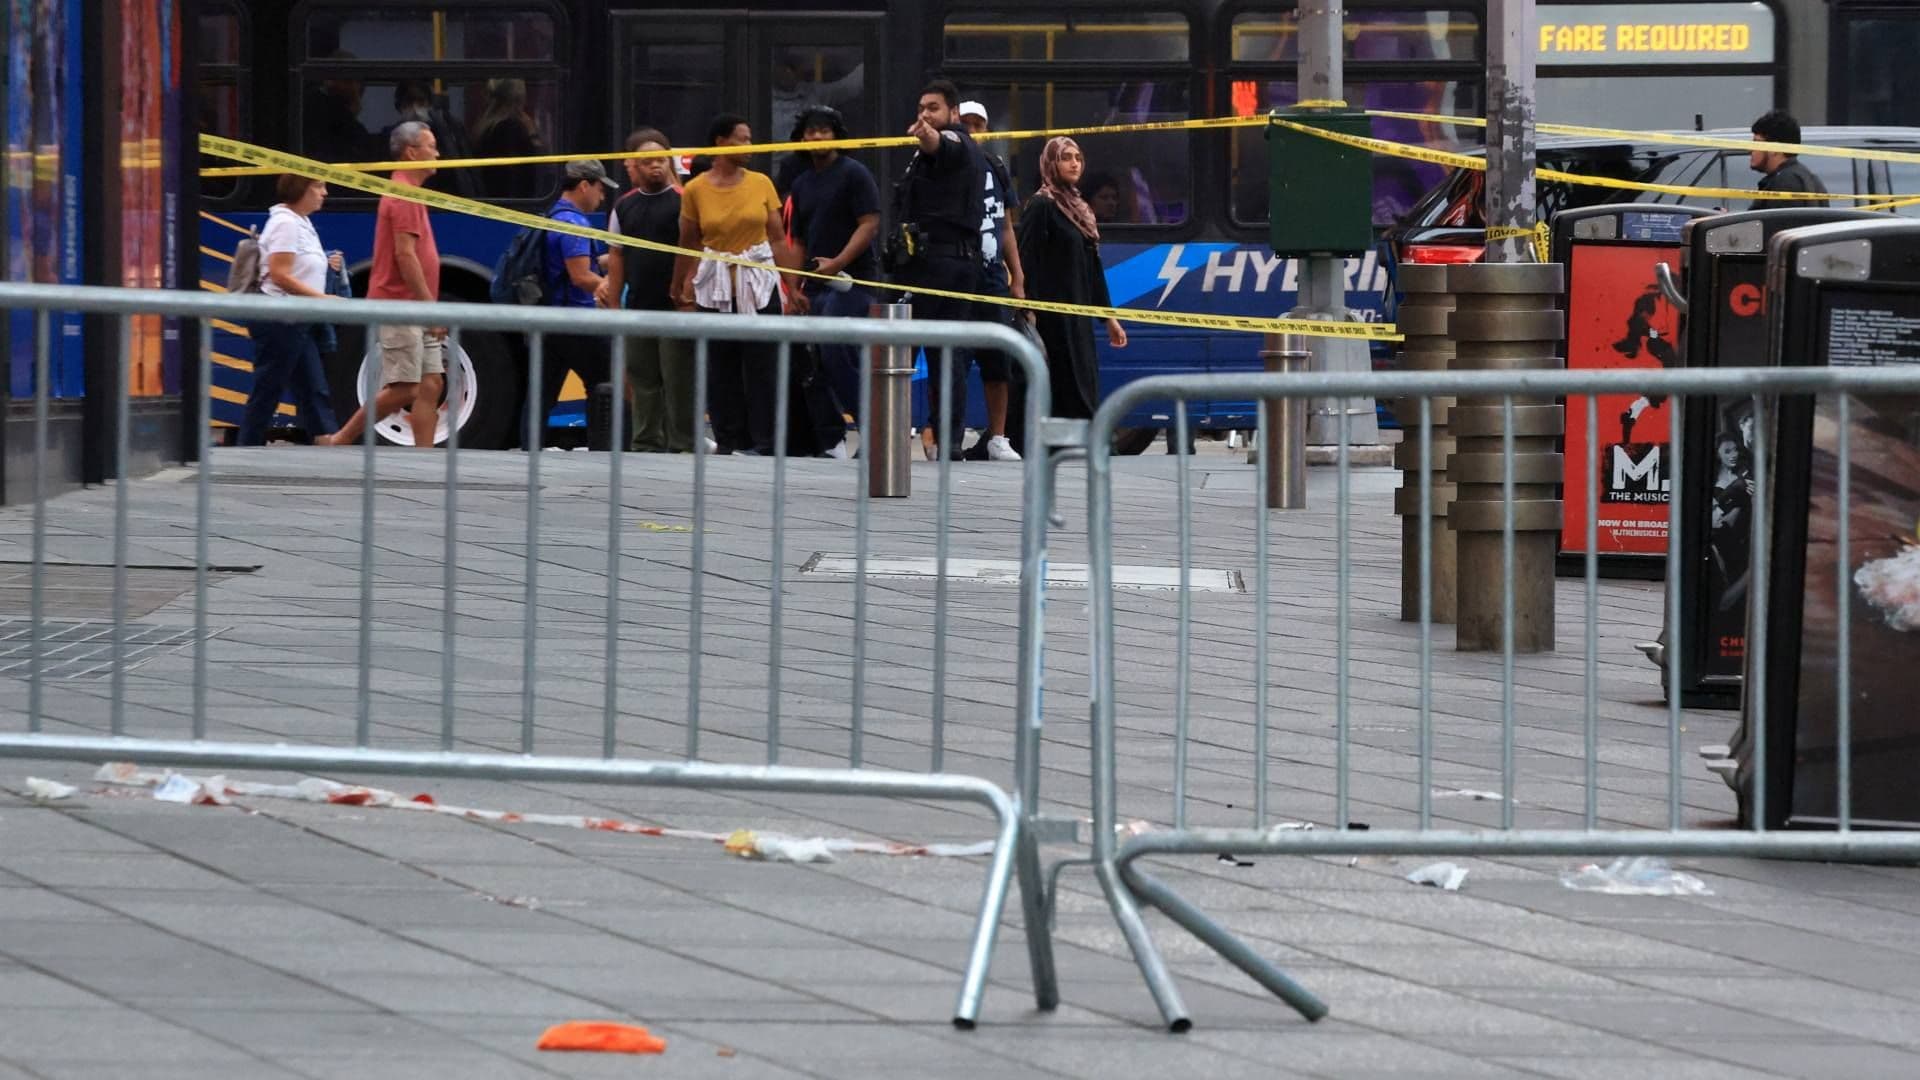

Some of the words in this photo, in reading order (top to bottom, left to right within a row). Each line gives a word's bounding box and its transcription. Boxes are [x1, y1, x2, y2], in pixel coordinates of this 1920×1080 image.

[1539, 24, 1607, 51] FARE
[1616, 24, 1749, 51] REQUIRED
[1609, 492, 1631, 501] THE
[1633, 493, 1670, 502] MUSIC
[1622, 520, 1636, 528] ON
[1637, 521, 1669, 529] BROAD
[1720, 637, 1744, 646] CHI
